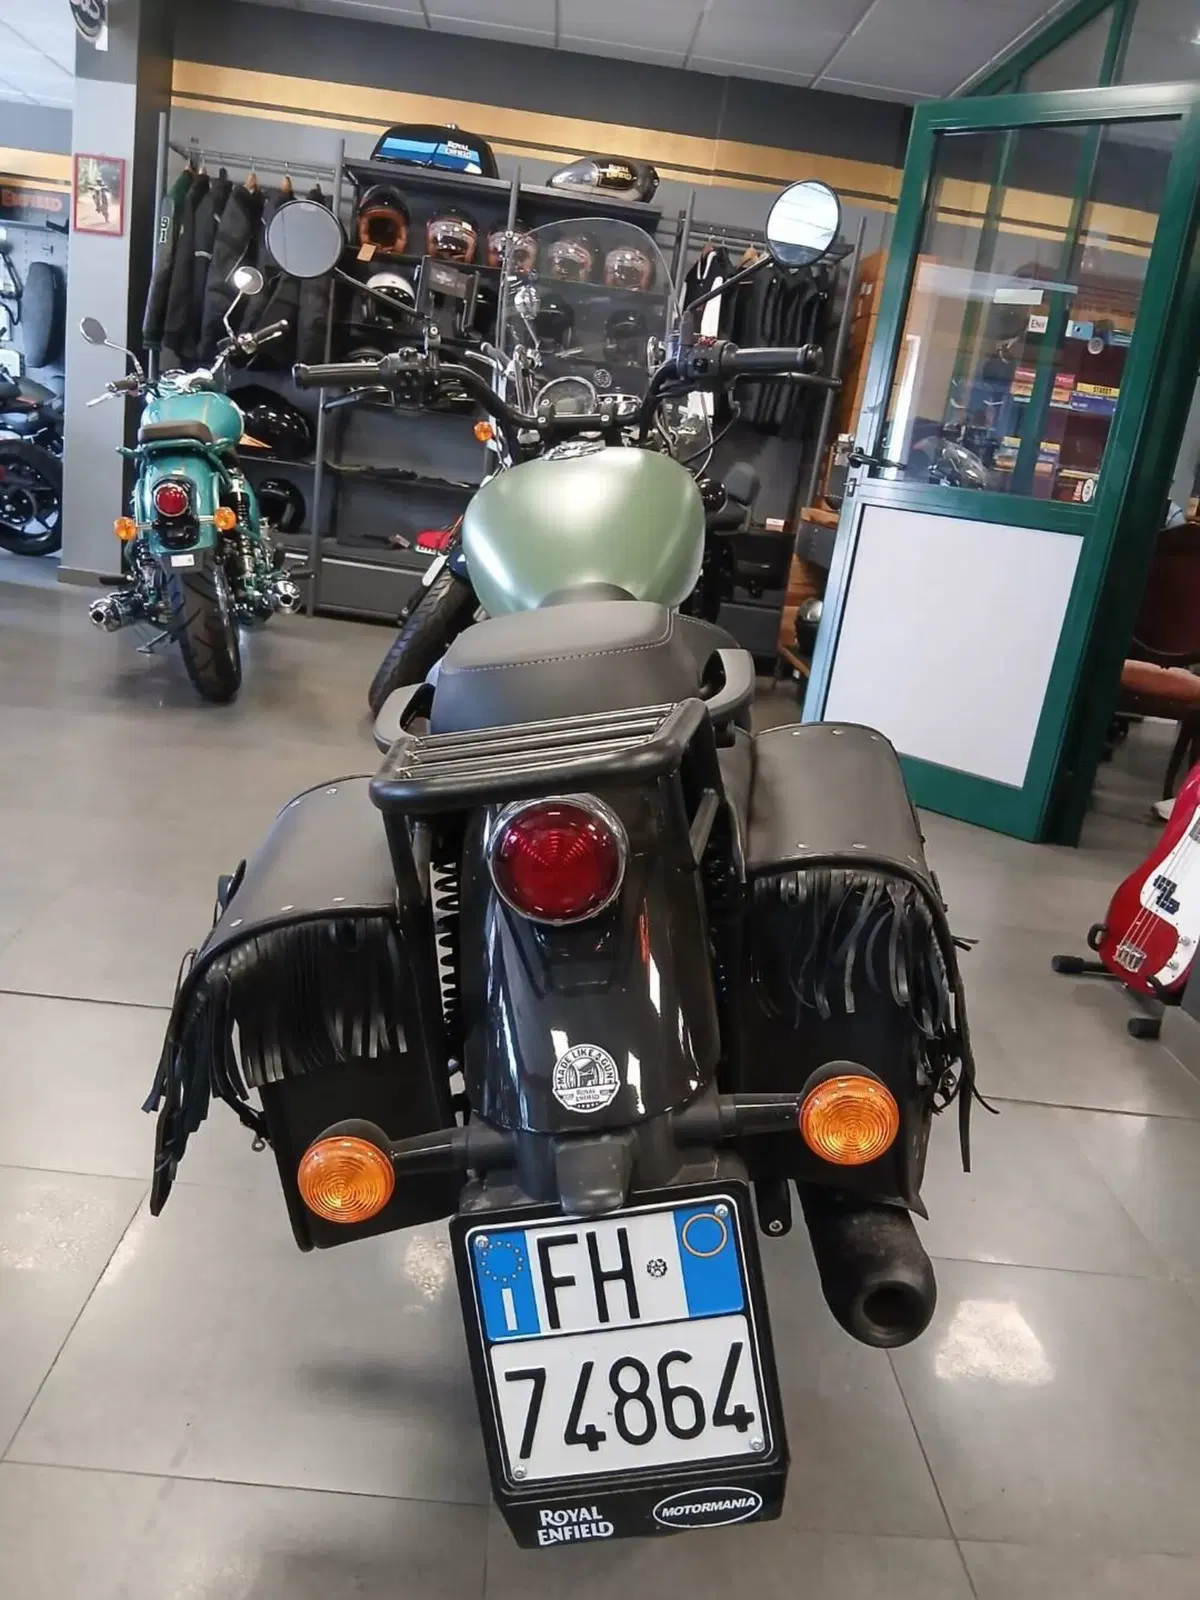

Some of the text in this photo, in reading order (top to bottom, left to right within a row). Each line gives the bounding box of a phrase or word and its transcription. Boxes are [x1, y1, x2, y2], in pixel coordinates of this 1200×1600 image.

[557, 1056, 571, 1085] MADE
[572, 1048, 594, 1058] LIKE
[600, 1058, 614, 1079] GUN
[536, 1227, 641, 1330] FH
[501, 1287, 518, 1331] I
[504, 1341, 755, 1460] 74864
[539, 1506, 603, 1527] ROYAL
[661, 1497, 756, 1518] MOTORMANIA
[537, 1521, 615, 1546] ENFIELD
